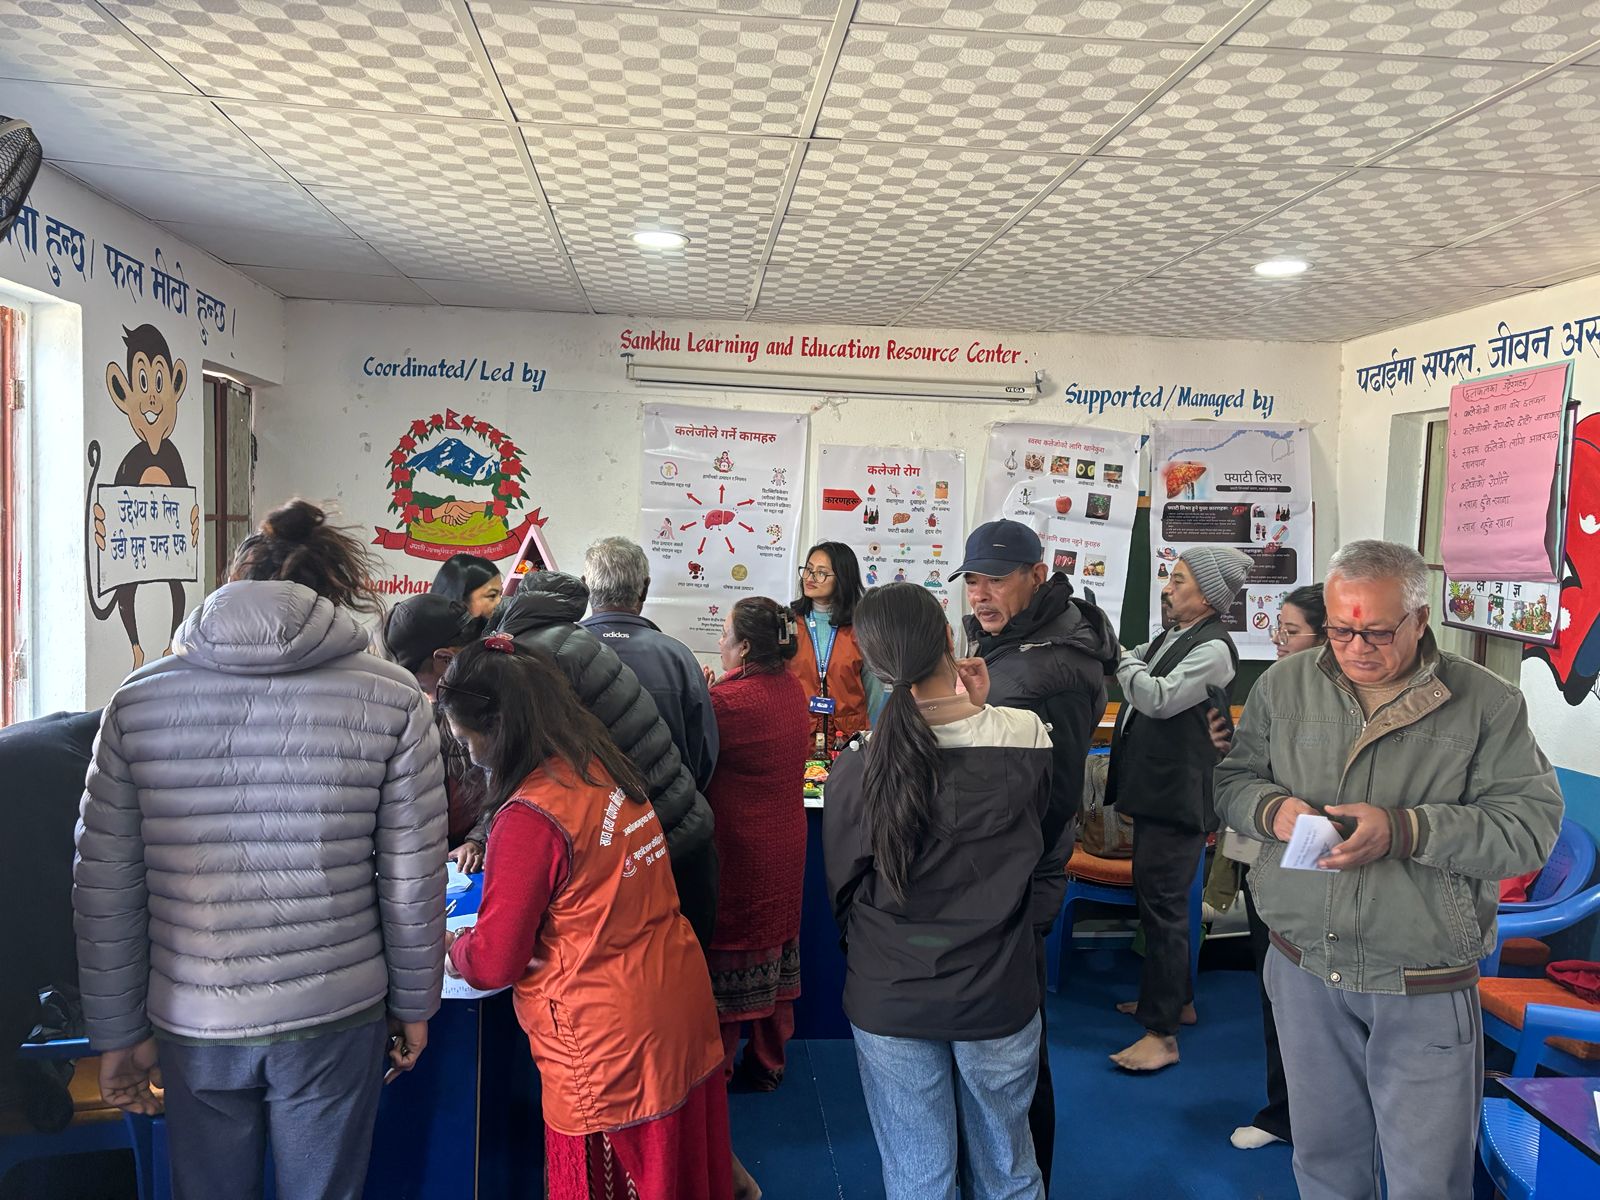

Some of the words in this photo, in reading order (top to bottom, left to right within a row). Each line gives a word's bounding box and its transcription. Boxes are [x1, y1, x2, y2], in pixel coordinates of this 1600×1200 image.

[104, 243, 144, 303] फल
[151, 248, 189, 317] मीठो
[620, 329, 680, 352] Sankhu
[688, 331, 759, 362] Learning
[766, 336, 793, 356] and
[801, 336, 880, 359] Education
[887, 339, 959, 362] Resource
[1488, 321, 1554, 368] जीवन
[522, 363, 546, 392] by
[1253, 389, 1274, 419] by
[674, 423, 718, 439] कलेजोले
[720, 427, 738, 440] गर्ने
[867, 462, 901, 476] कलेजो
[903, 464, 921, 477] रोग
[1224, 470, 1253, 484] फ्याटी
[1255, 470, 1282, 484] लिभर
[150, 491, 158, 520] के
[172, 534, 187, 555] एक
